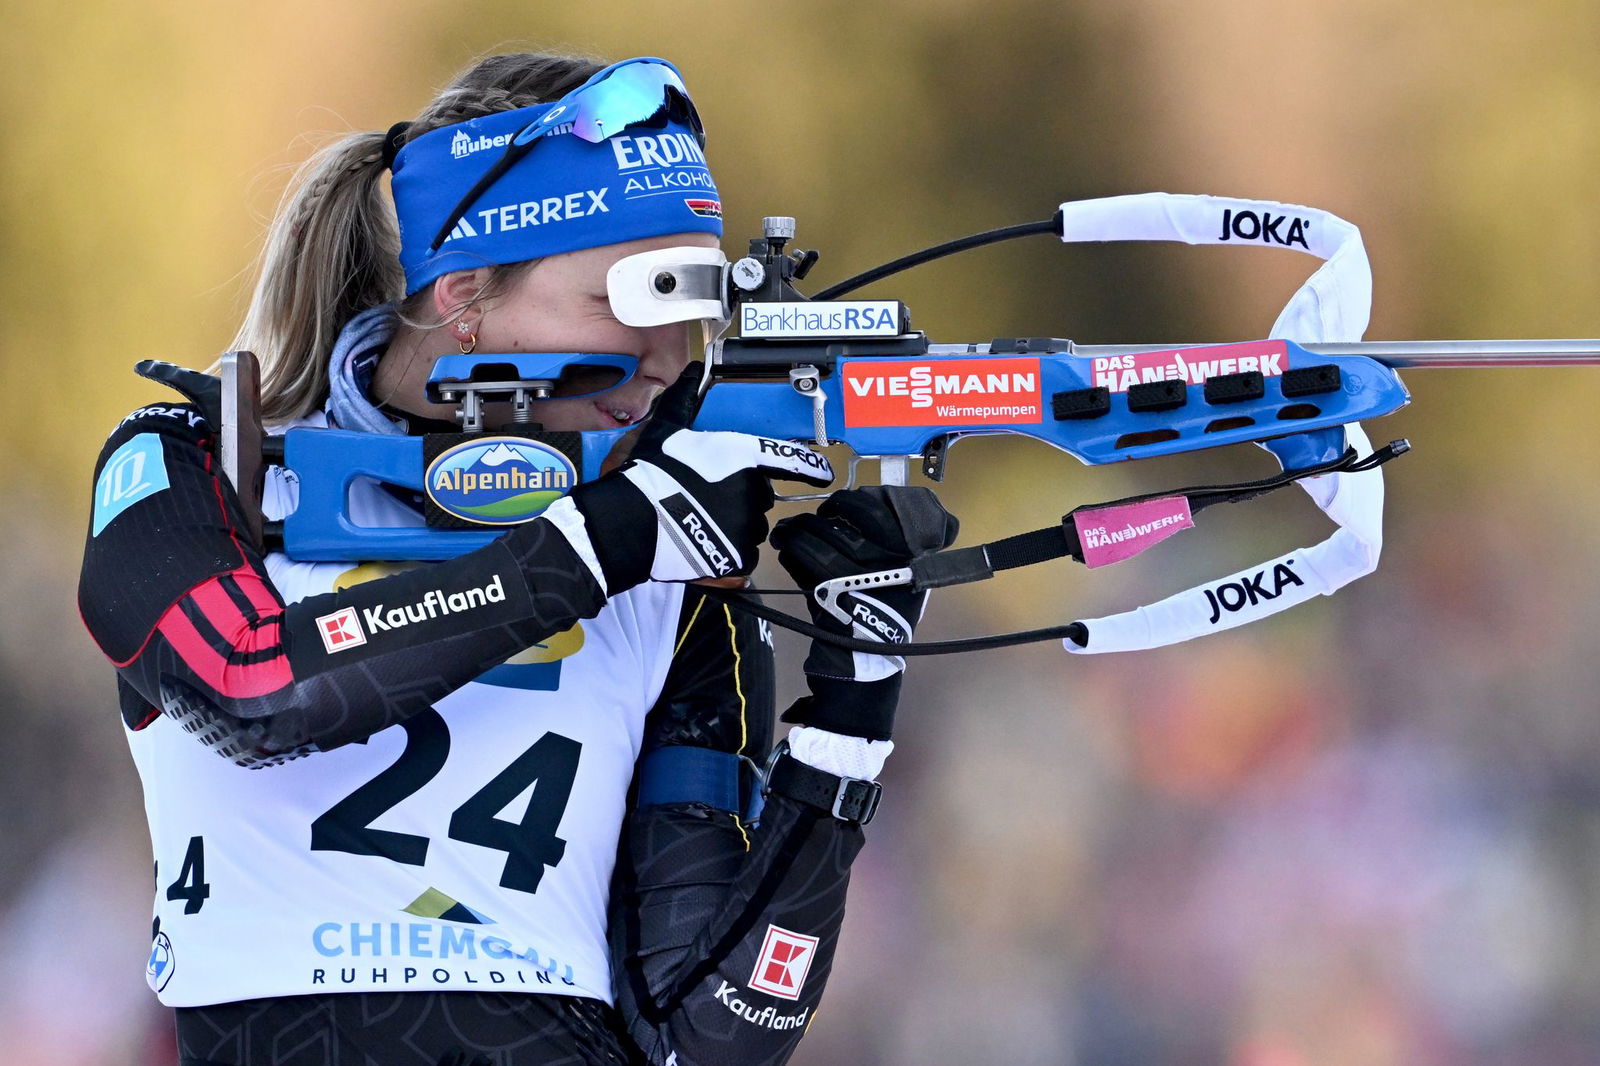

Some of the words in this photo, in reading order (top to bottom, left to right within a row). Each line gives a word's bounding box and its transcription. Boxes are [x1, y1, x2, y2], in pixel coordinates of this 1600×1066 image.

[478, 187, 610, 236] TERREX
[1219, 209, 1311, 250] JOKA
[1095, 355, 1136, 372] DAS
[848, 366, 1036, 408] VIESSMANN
[936, 404, 1037, 418] Wärmepumpen
[434, 466, 569, 495] Alpenhain
[1083, 526, 1107, 538] DAS
[362, 574, 507, 635] Kaufland
[1203, 558, 1305, 625] JOKA
[310, 704, 583, 895] 24
[155, 835, 210, 915] 4
[713, 979, 809, 1031] Kaufland
